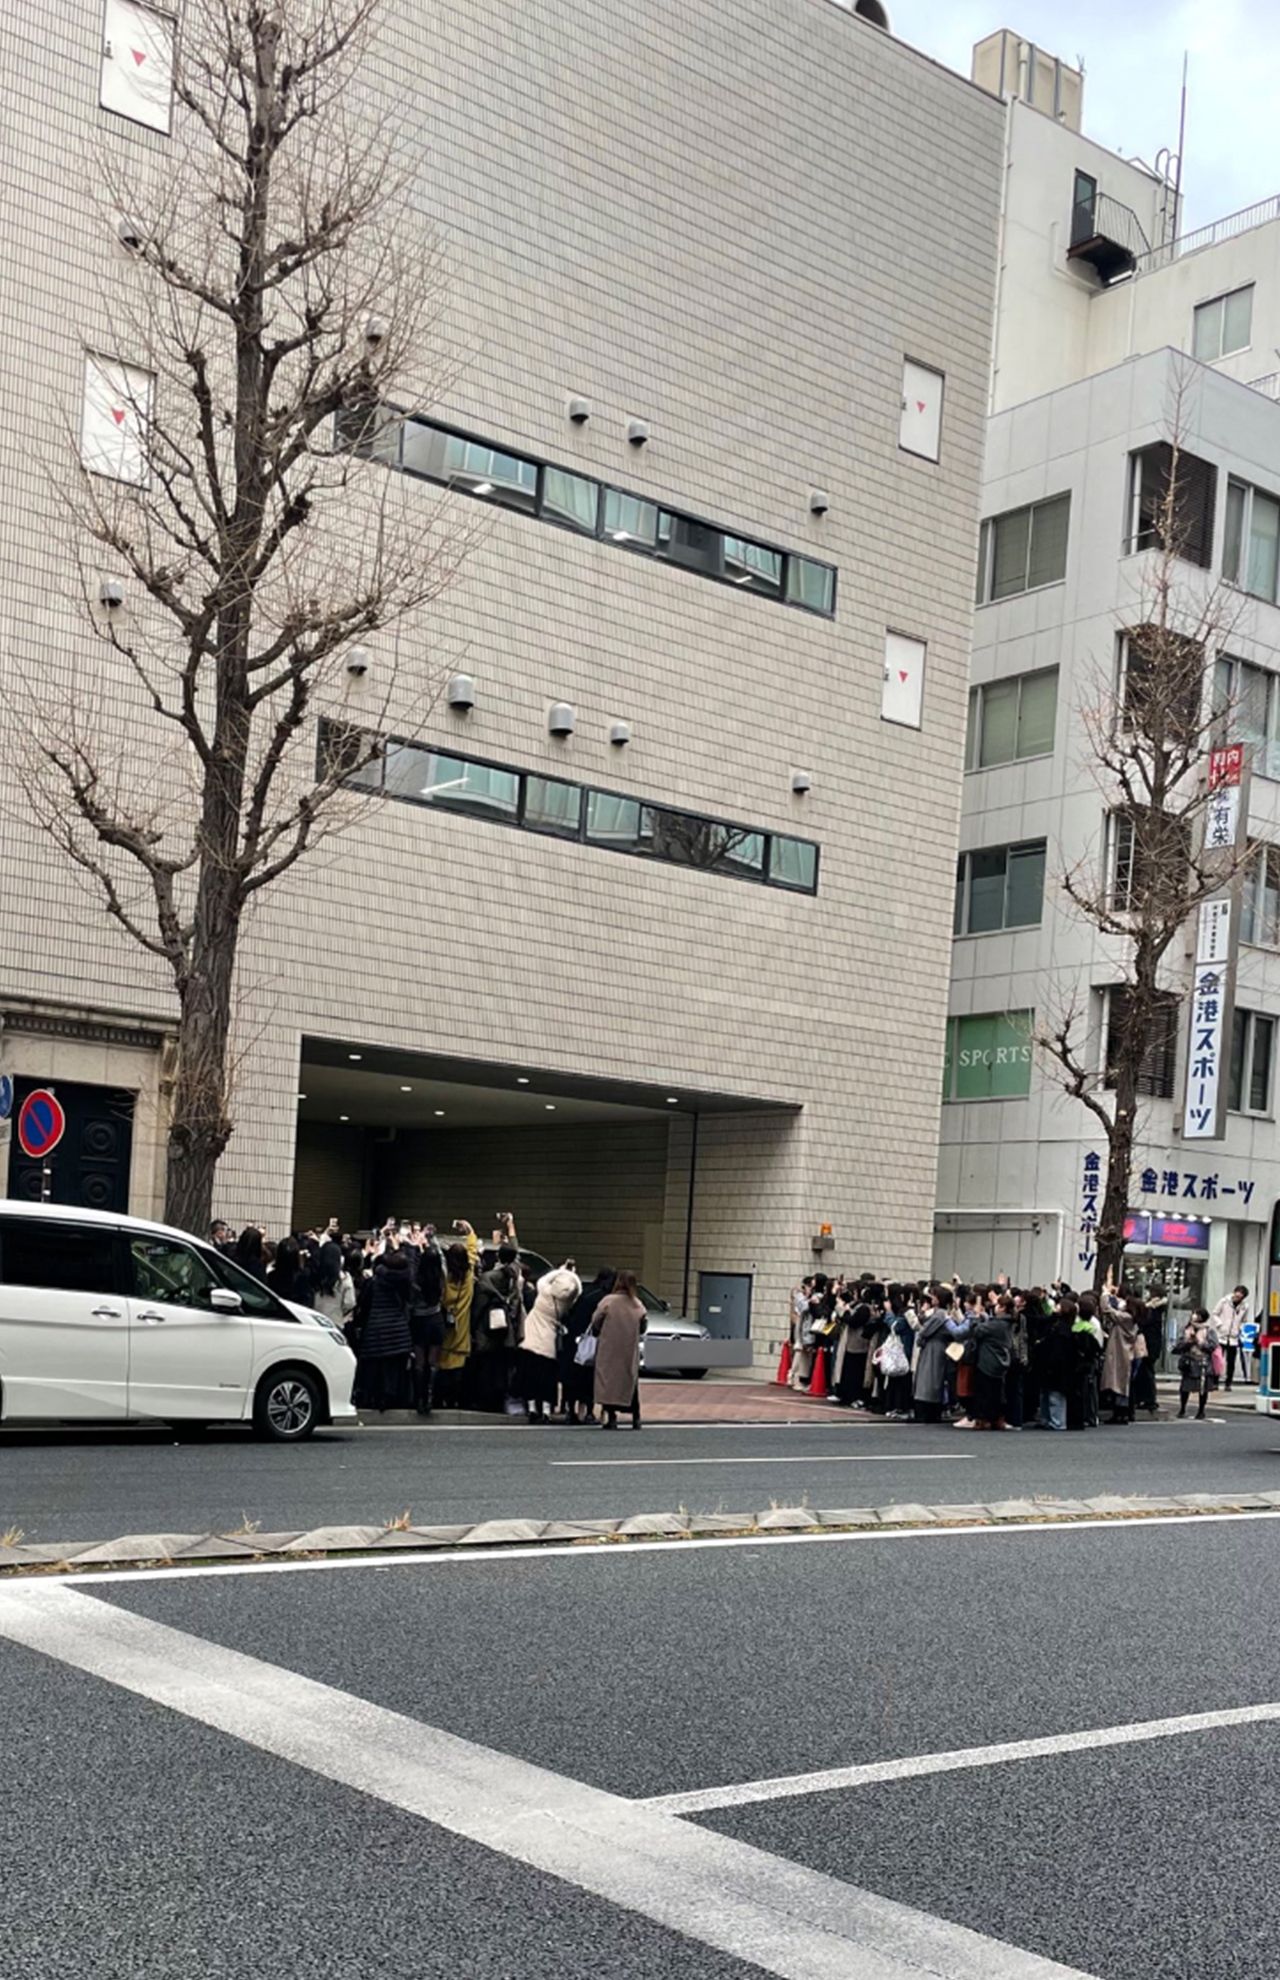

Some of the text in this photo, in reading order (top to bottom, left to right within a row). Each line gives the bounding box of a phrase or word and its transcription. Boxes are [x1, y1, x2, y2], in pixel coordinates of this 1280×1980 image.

[1190, 971, 1220, 1130] 金港スポーツ
[1078, 1150, 1101, 1271] 金港スポーツ
[1140, 1167, 1255, 1204] 金港スポーツ
